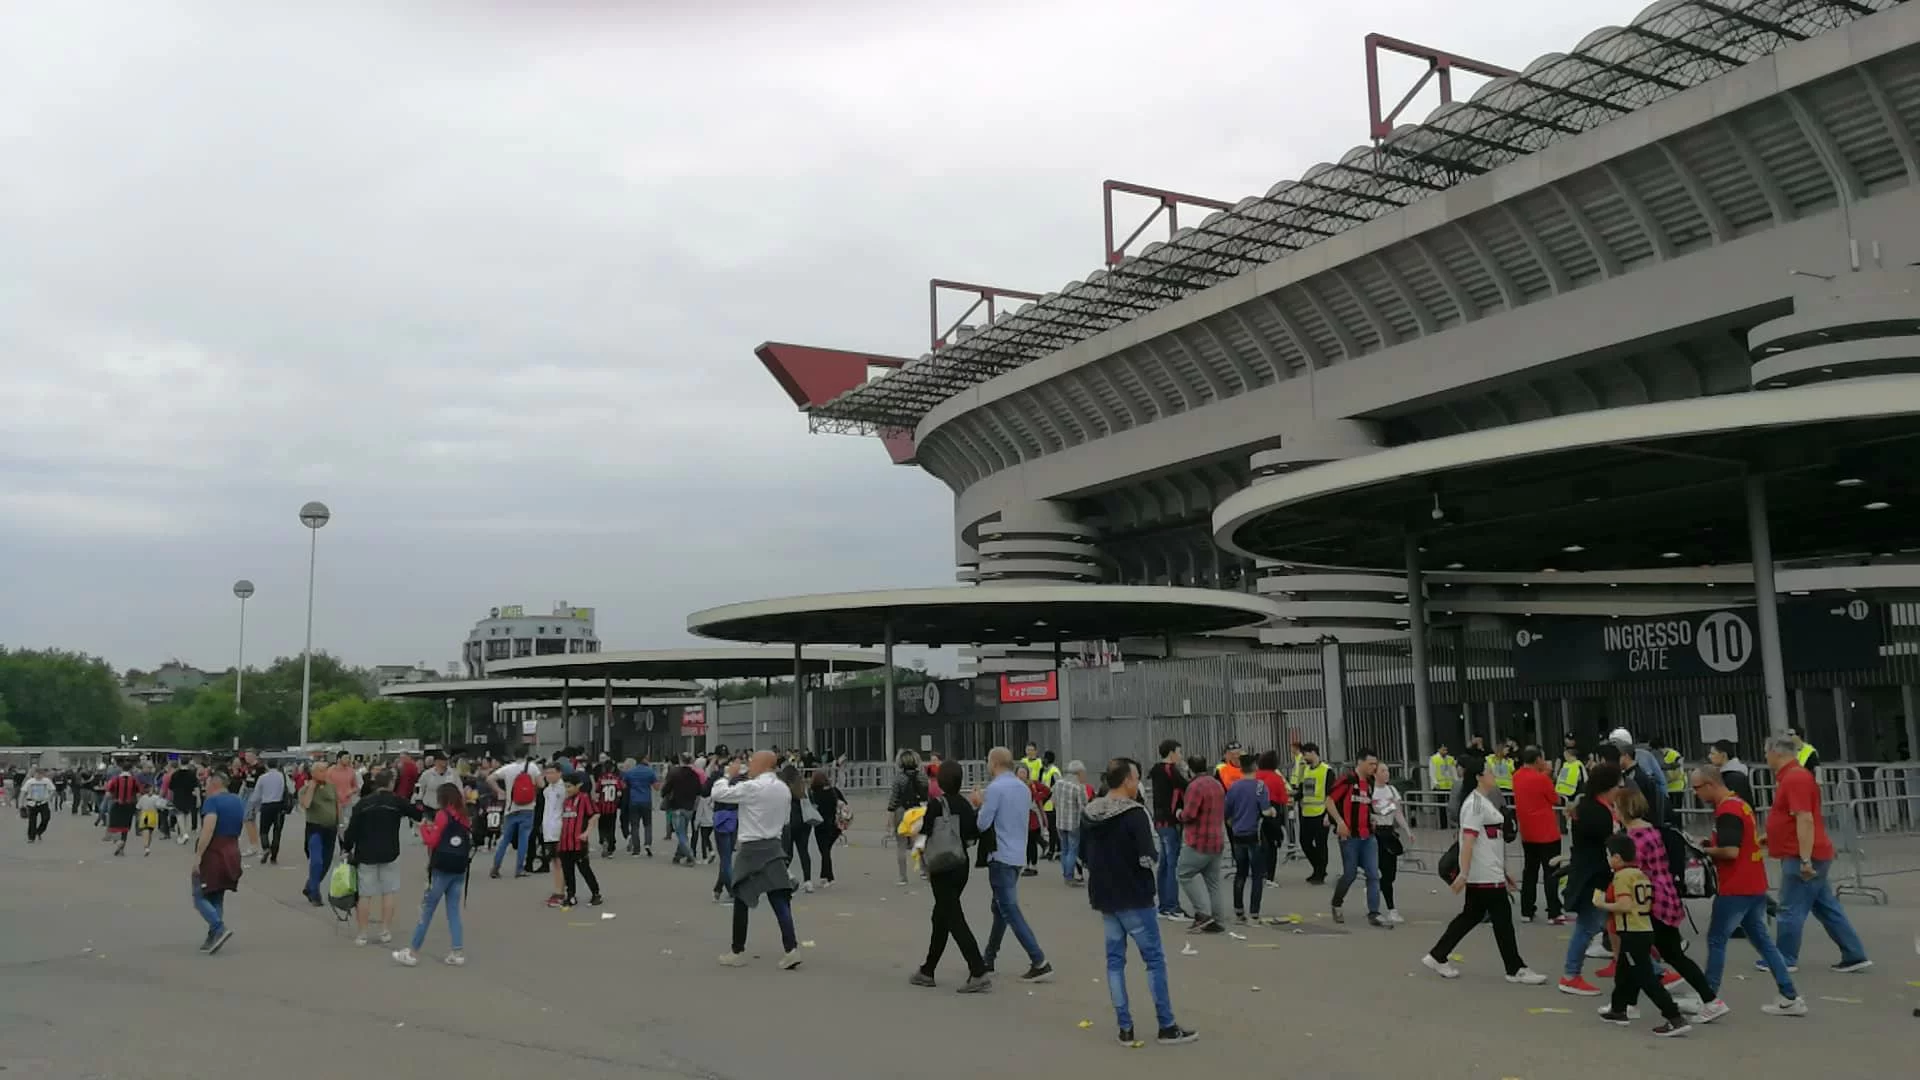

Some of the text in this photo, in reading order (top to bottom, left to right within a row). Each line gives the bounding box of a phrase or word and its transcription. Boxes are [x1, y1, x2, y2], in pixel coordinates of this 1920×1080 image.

[1604, 621, 1691, 650] INGRESSO
[1705, 619, 1744, 664] 10
[1629, 647, 1669, 672] GATE
[602, 784, 616, 802] 10
